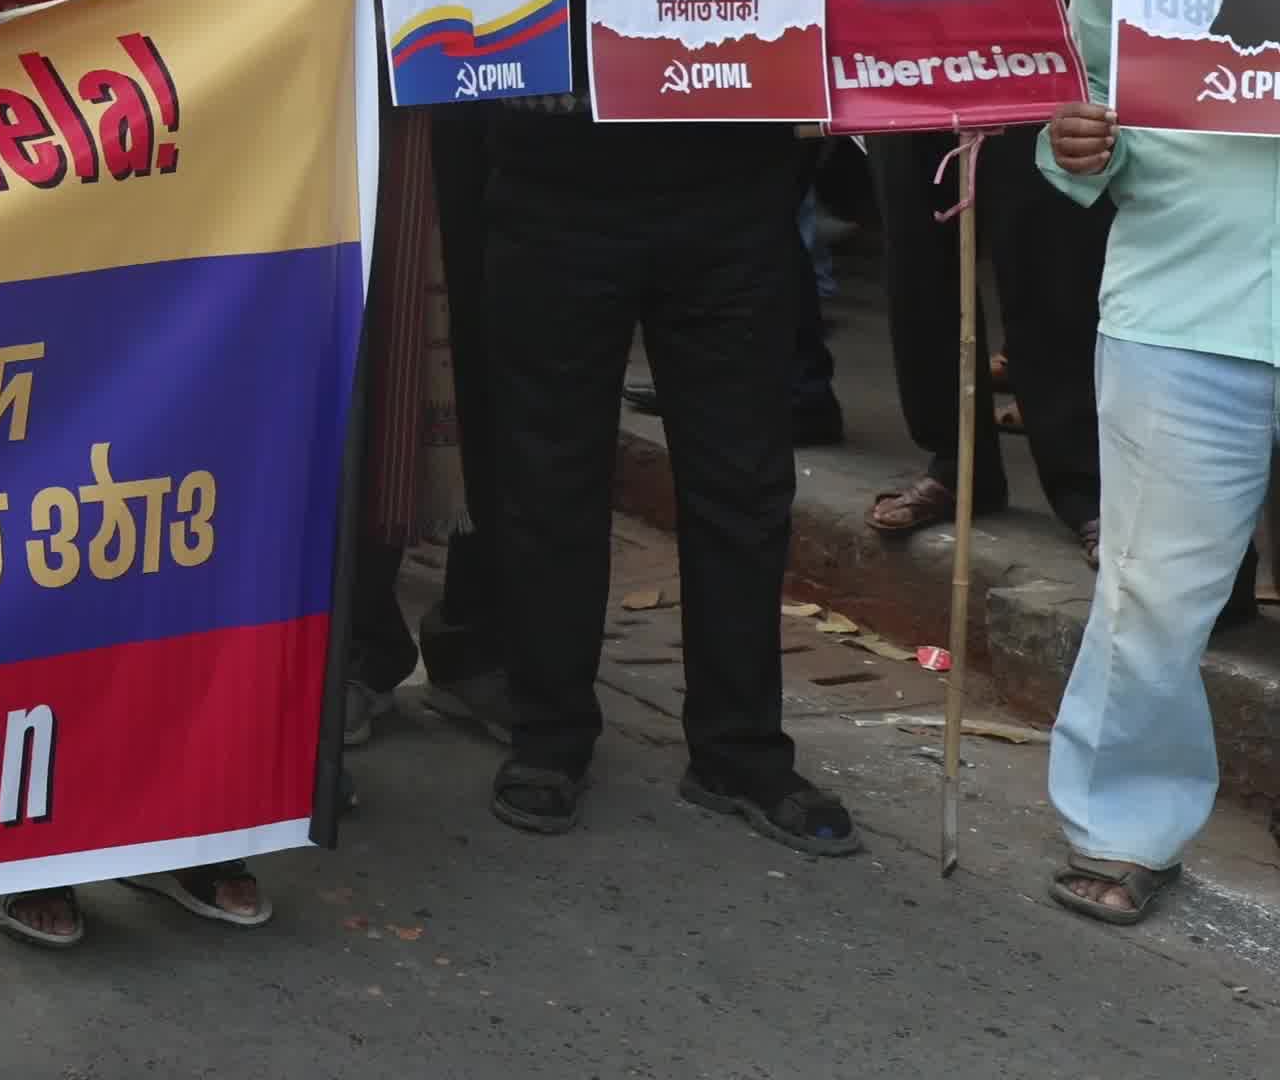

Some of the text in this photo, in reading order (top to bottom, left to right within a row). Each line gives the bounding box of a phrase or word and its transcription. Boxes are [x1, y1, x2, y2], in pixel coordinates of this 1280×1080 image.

[716, 0, 759, 21] যাক!
[478, 63, 524, 92] CPIML
[692, 63, 752, 89] CPIML
[832, 45, 1068, 89] Liberation
[25, 442, 217, 589] ওঠাও
